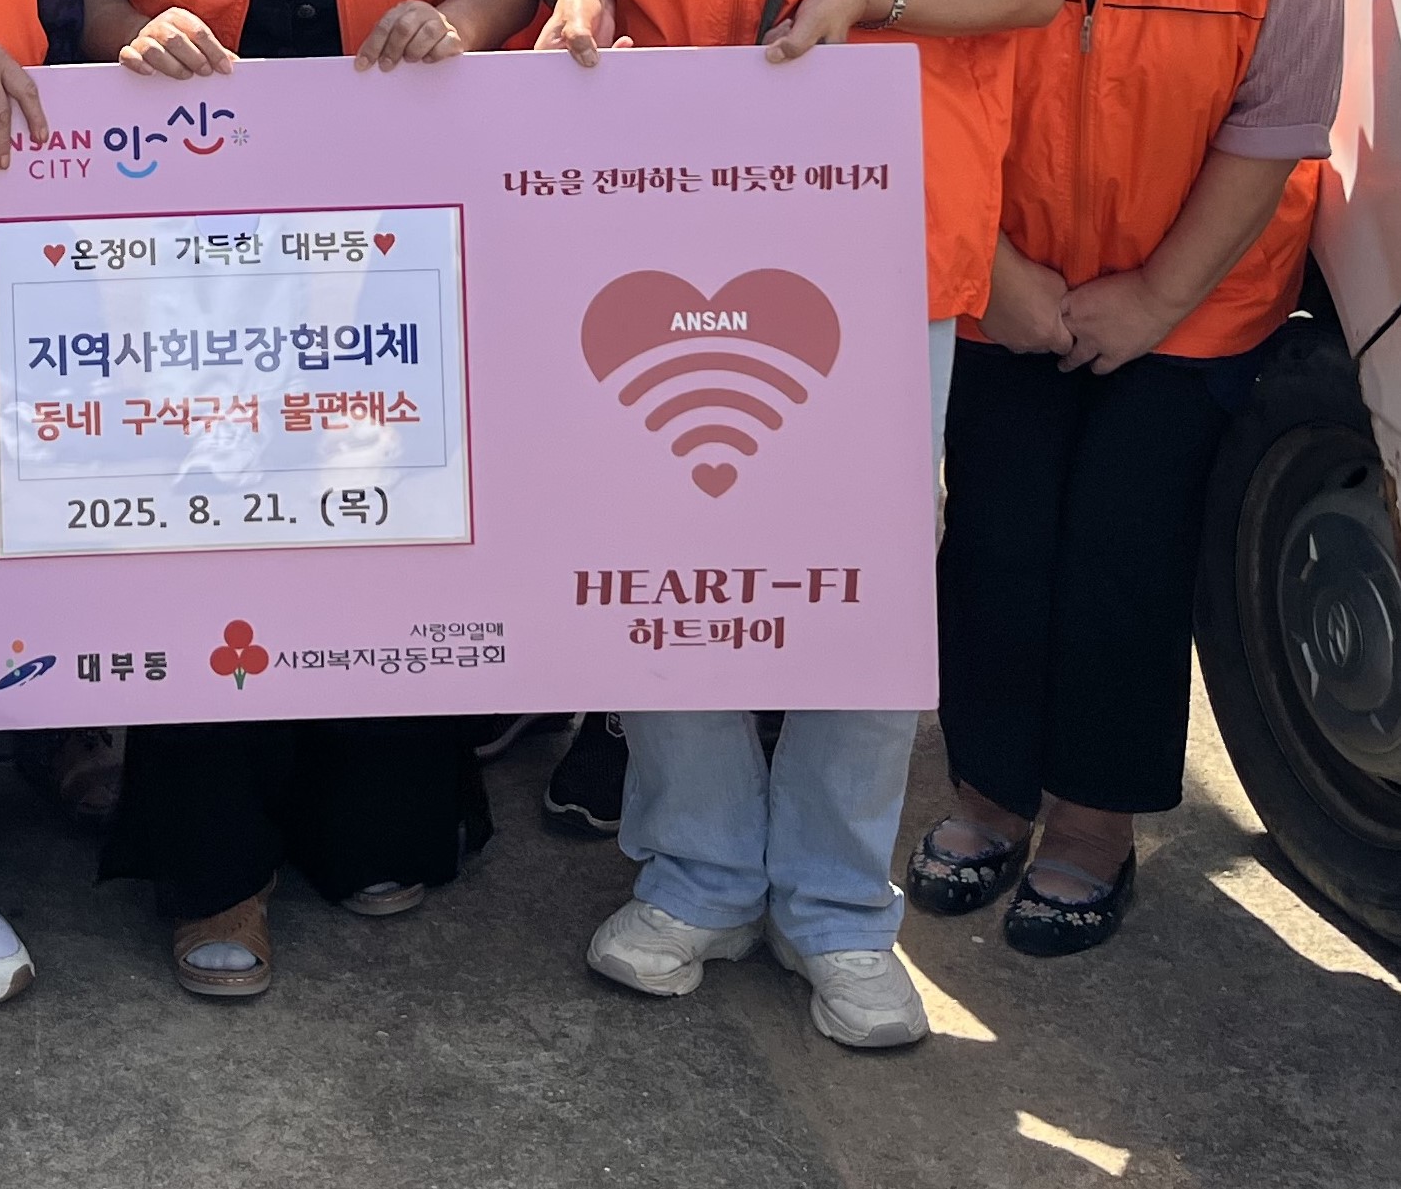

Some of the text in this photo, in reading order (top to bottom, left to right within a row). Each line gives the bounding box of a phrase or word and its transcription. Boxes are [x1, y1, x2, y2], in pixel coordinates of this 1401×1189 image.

[28, 158, 91, 180] CITY
[504, 163, 889, 196] 나눔을 전파하는 따듯한 에너지
[69, 230, 369, 271] 온정이 가득한 대부동
[670, 310, 748, 332] ANSAN
[27, 321, 419, 379] 지역사회보장협의체
[31, 390, 421, 442] 동네 구석구석 불편해소
[66, 485, 390, 530] 2025. 8. 21. (목)
[574, 567, 862, 606] HEART-FI
[409, 621, 505, 644] 사랑의열매
[627, 616, 786, 651] 하트파이
[76, 650, 168, 684] 대부동
[273, 644, 507, 675] 사회복지공동모금회
